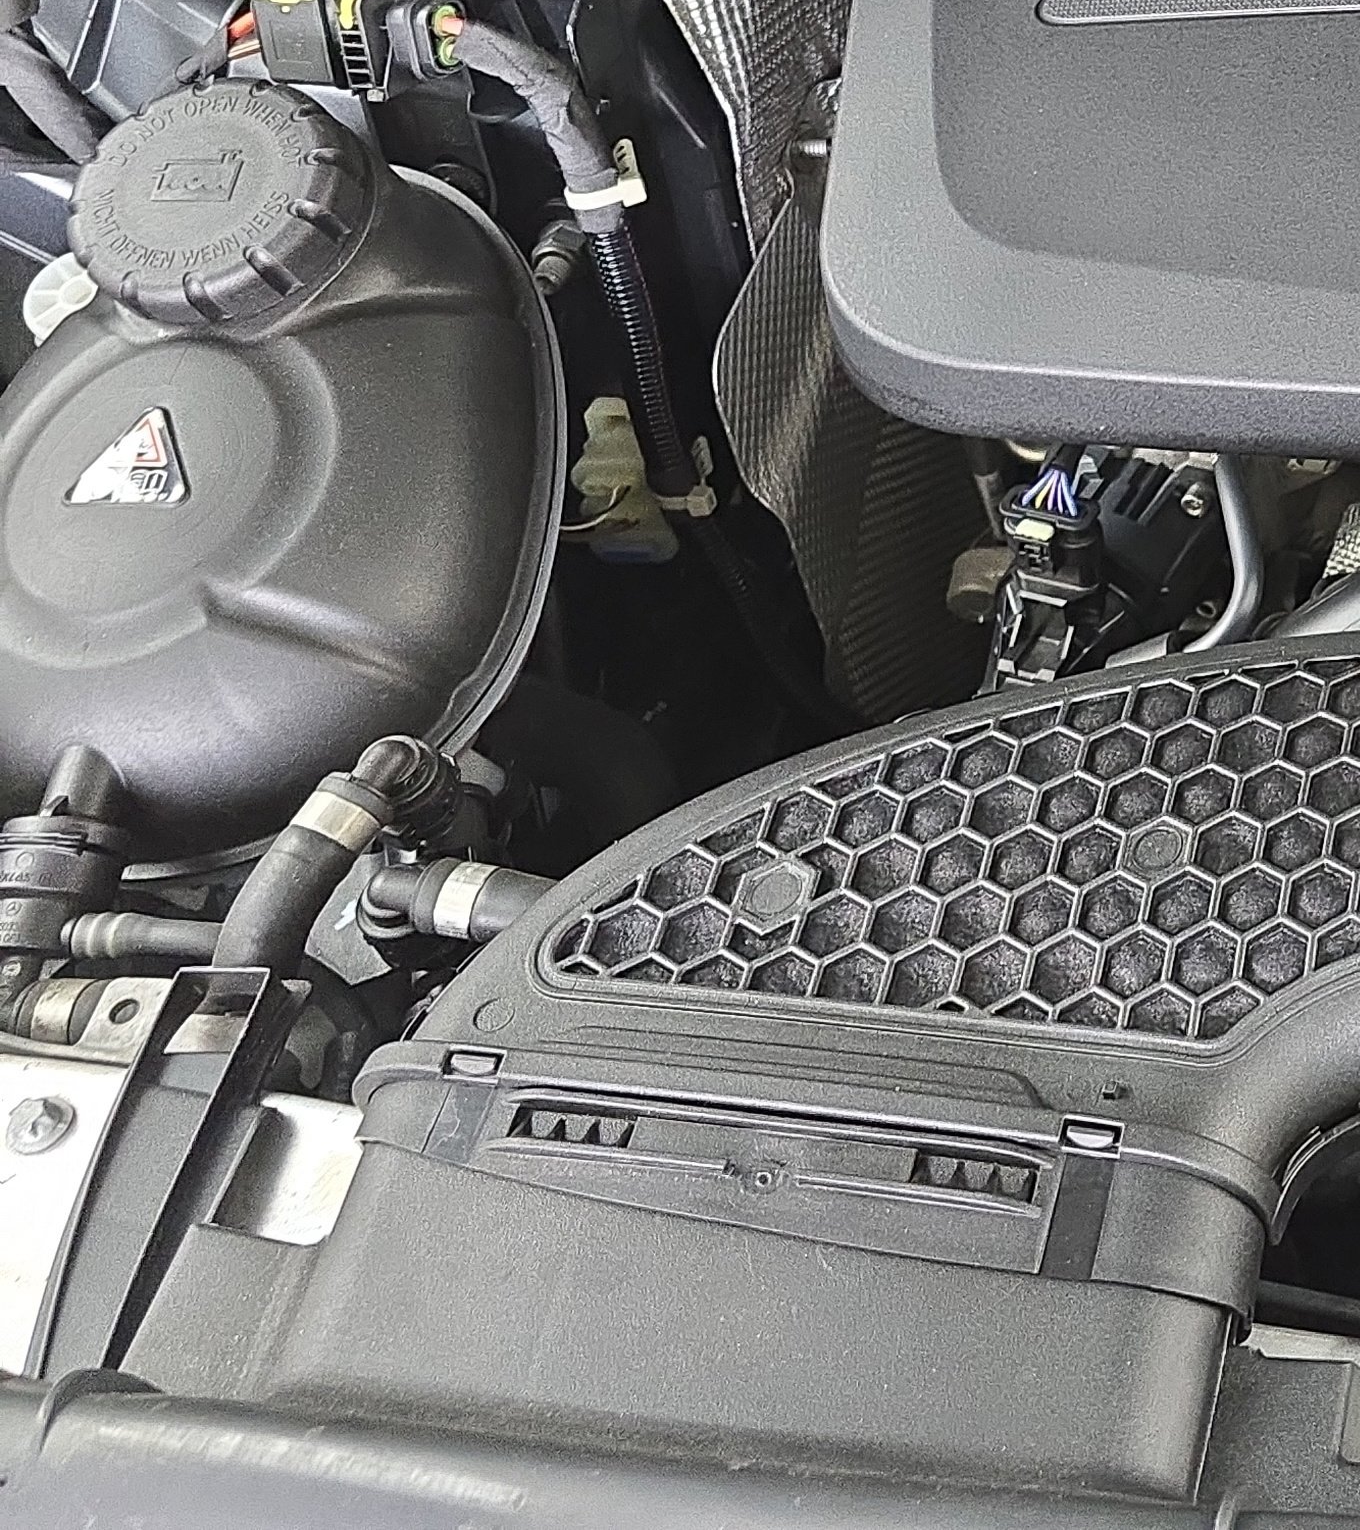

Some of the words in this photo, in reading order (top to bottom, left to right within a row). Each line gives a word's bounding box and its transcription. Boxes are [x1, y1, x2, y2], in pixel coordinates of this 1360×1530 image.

[108, 143, 137, 167] DO
[137, 108, 175, 142] NOT
[184, 96, 237, 117] OPEN
[244, 99, 292, 137] WHEN
[93, 189, 120, 238] NICHT
[182, 234, 240, 267] WENN
[241, 190, 290, 239] HEISS
